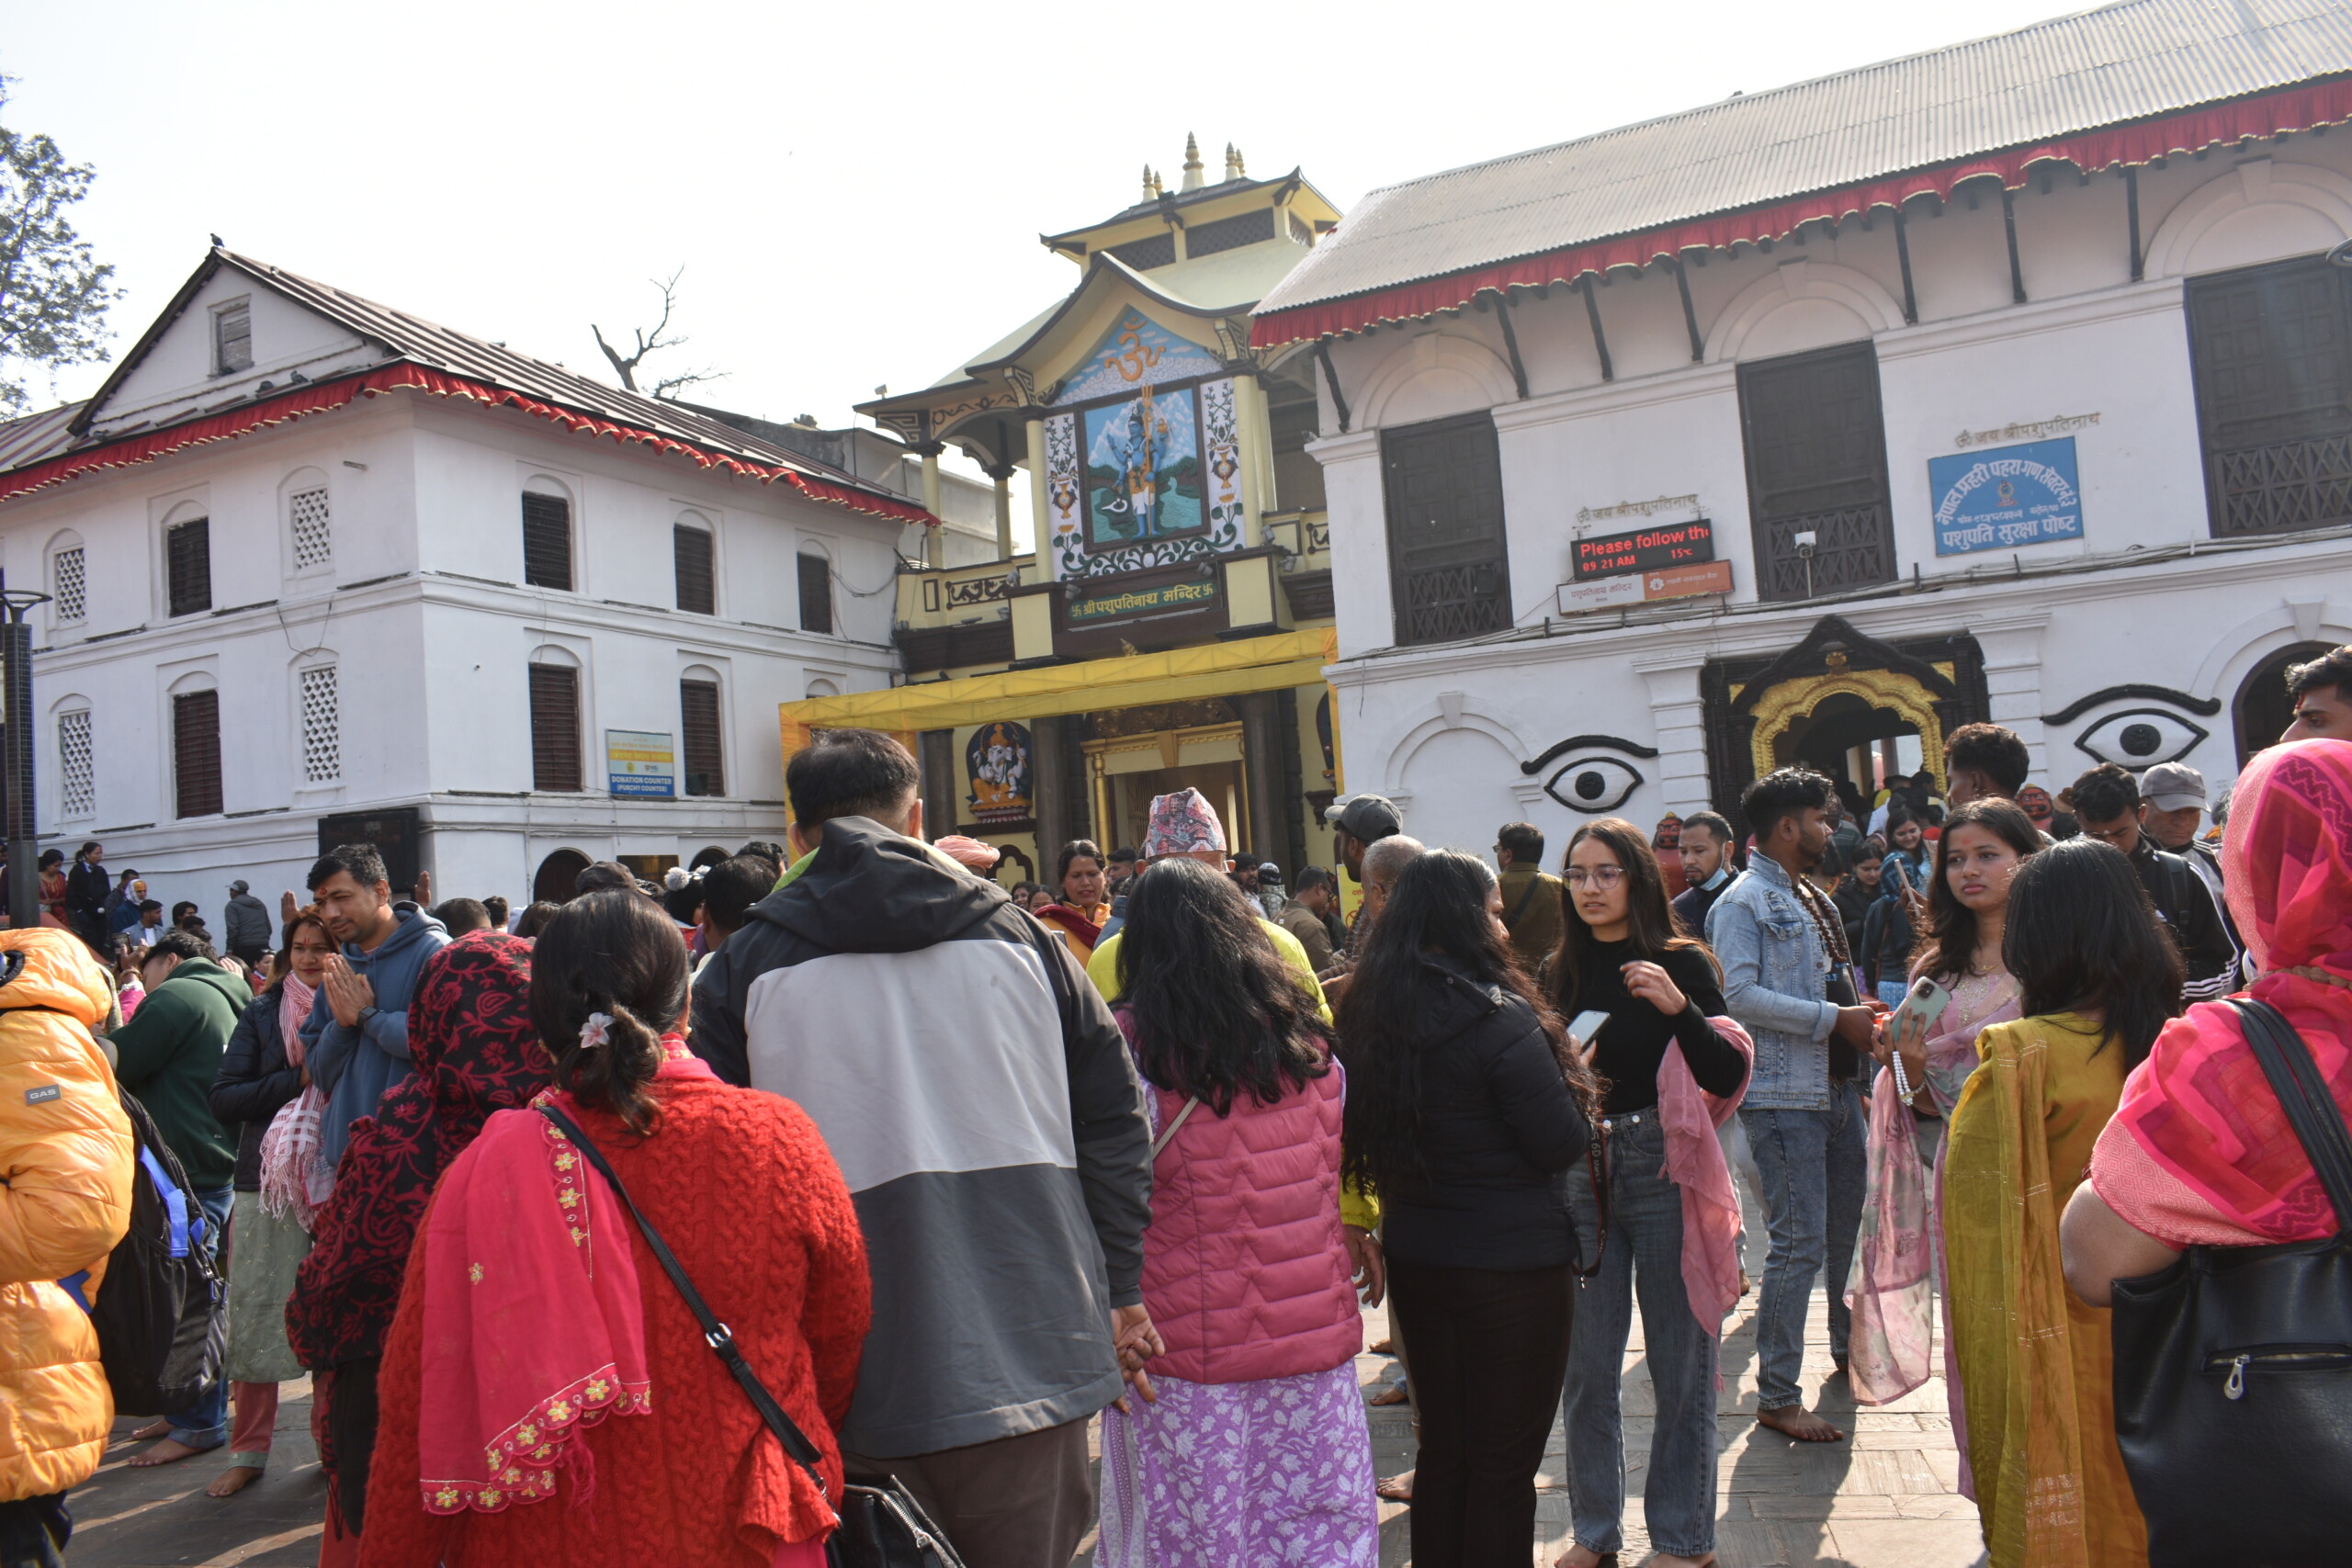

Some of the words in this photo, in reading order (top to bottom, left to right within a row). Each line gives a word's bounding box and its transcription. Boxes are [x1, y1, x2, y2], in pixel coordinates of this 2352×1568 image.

[1935, 488, 1964, 525] नेपाल
[1954, 463, 1991, 496] प्रहरी
[1988, 459, 2022, 477] पहरा
[2020, 460, 2045, 480] गण
[1942, 523, 1995, 550] पशुपति
[1998, 520, 2039, 545] सुरक्षा
[2041, 514, 2075, 534] पोष्ट
[1580, 540, 1634, 558] Please
[1635, 530, 1686, 549] follow
[1583, 561, 1597, 571] 09
[1601, 559, 1613, 569] 21
[1617, 555, 1636, 567] AM
[1162, 584, 1203, 603] मन्दिर
[611, 775, 644, 784] DONATION
[29, 1089, 57, 1100] GAS
